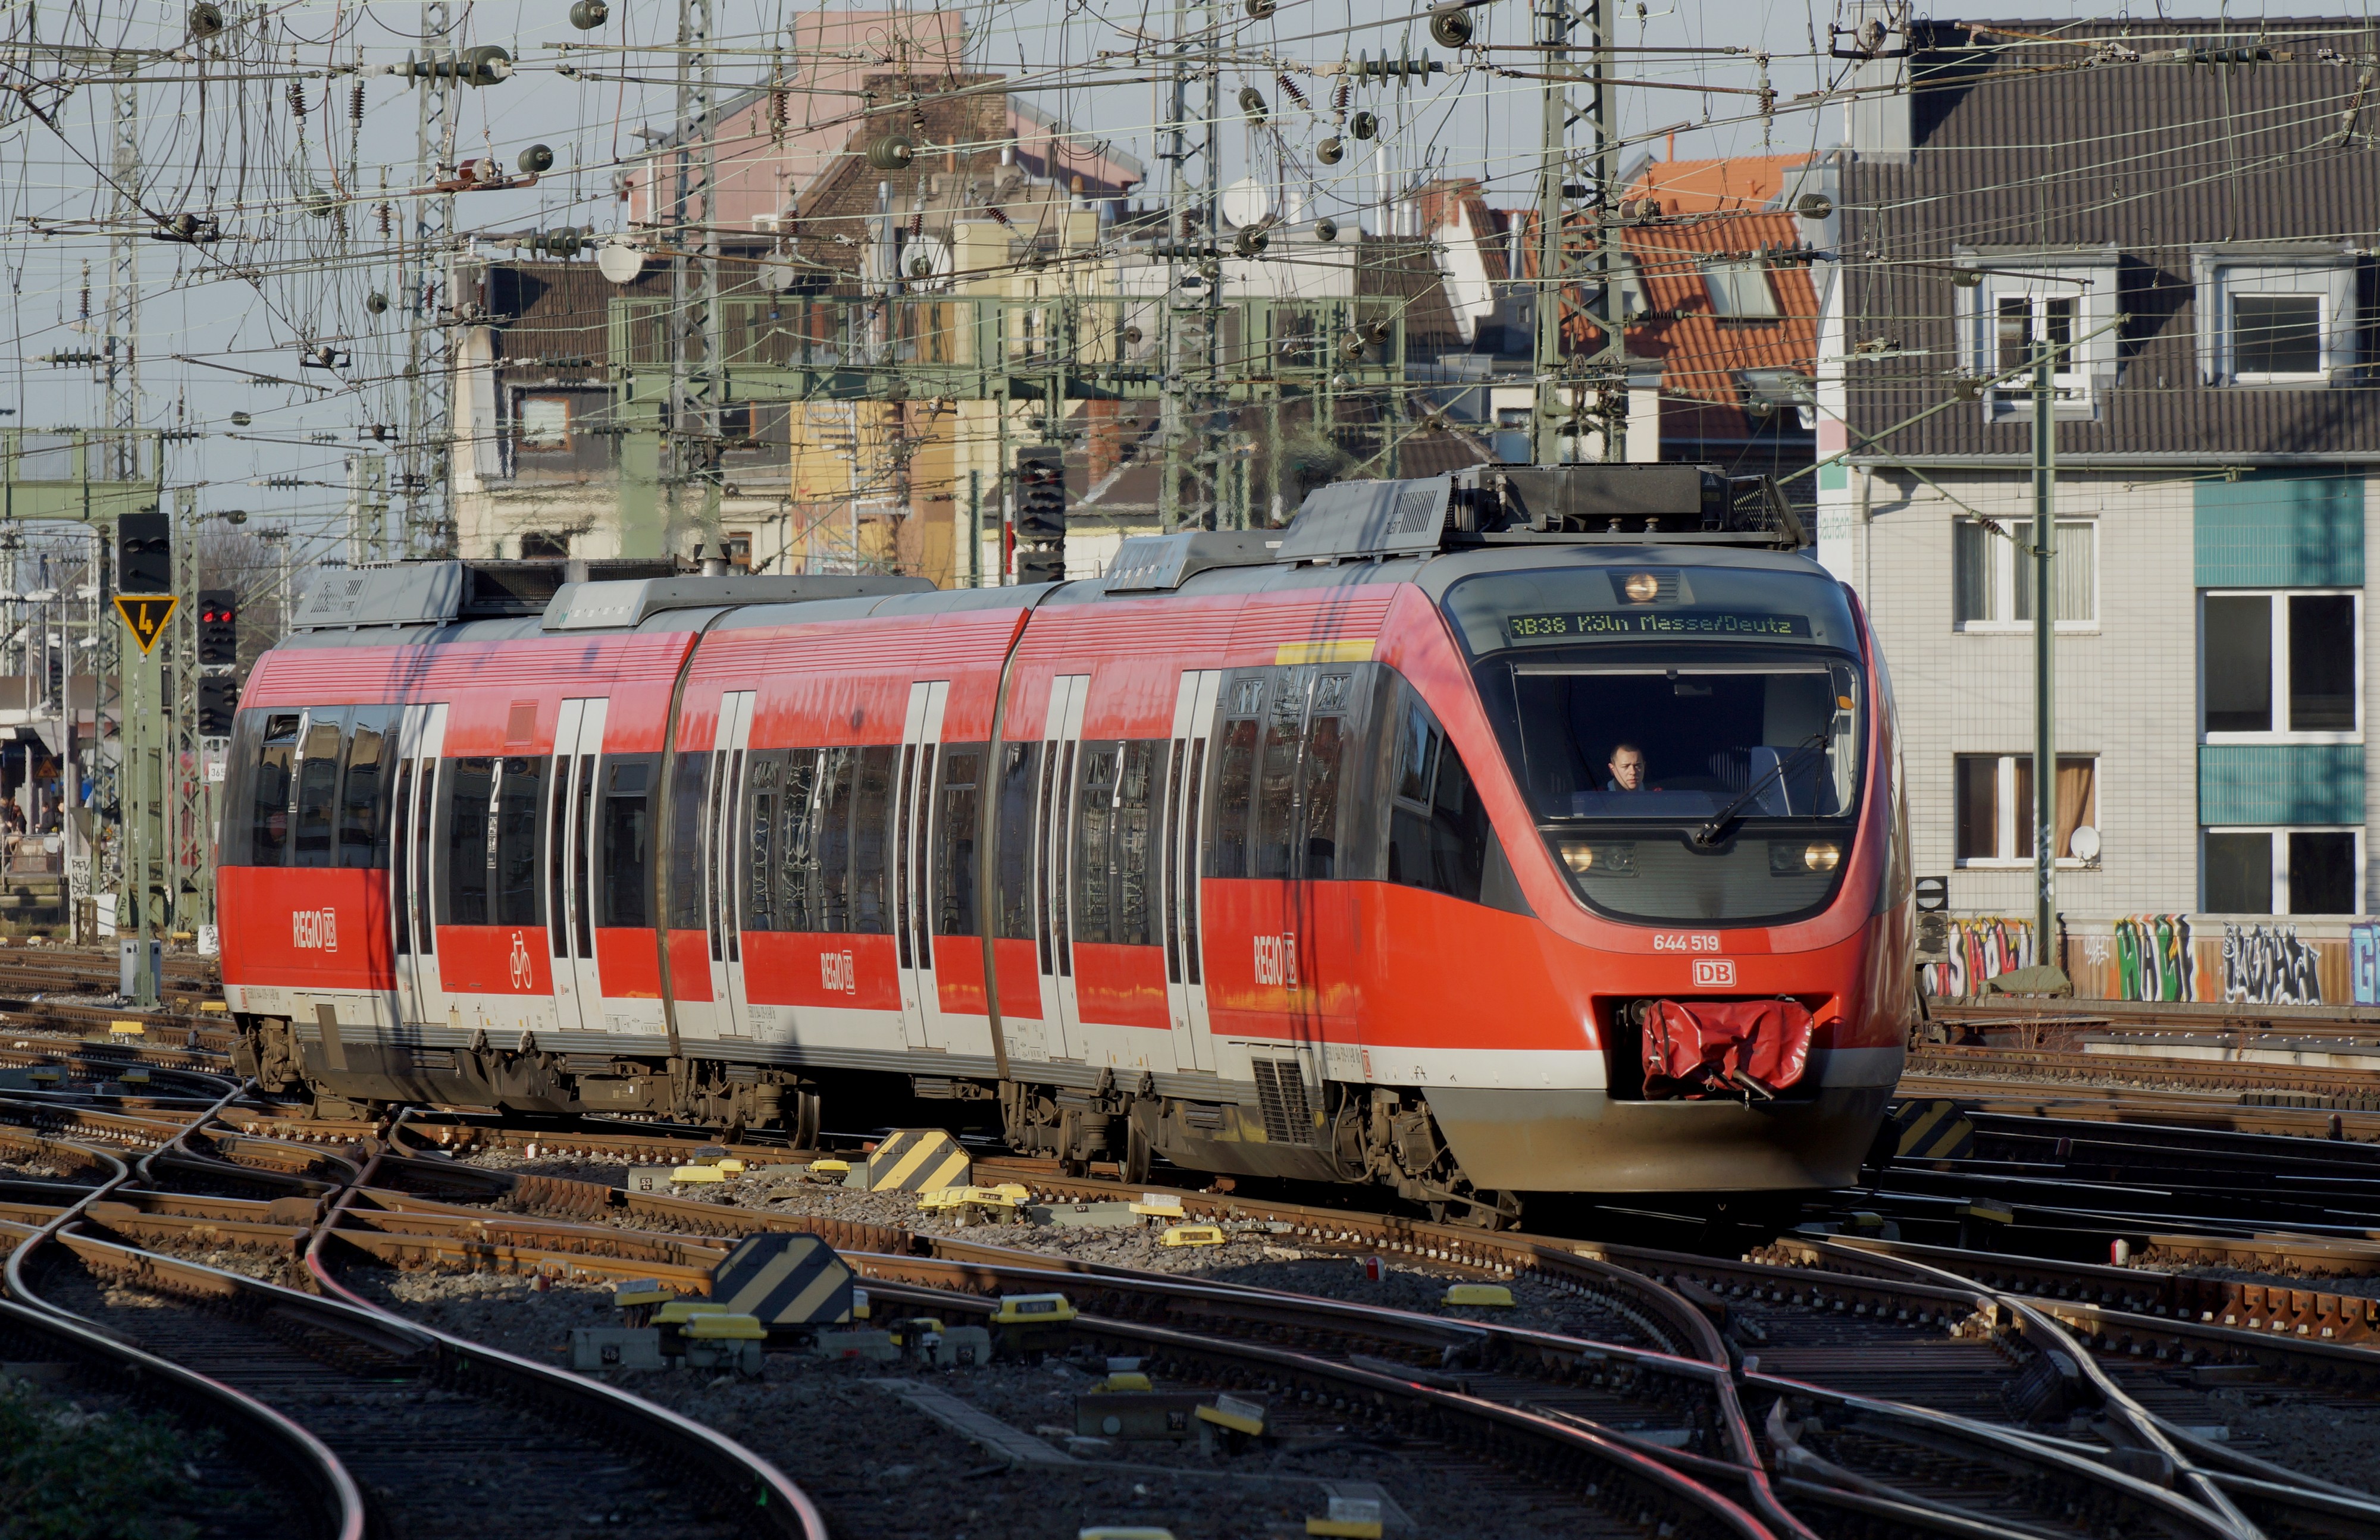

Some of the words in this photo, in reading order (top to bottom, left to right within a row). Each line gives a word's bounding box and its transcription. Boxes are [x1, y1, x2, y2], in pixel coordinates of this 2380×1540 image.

[138, 603, 153, 635] 4
[1512, 617, 1566, 635] RB38
[1577, 615, 1629, 632] Köln
[1640, 614, 1792, 633] Messe/Deutz
[294, 711, 308, 760] 2
[489, 761, 501, 812] 2
[814, 753, 824, 809] 2
[1113, 747, 1123, 807] 2
[293, 910, 322, 949] REGIO
[324, 912, 335, 948] DB
[1653, 934, 1686, 951] 644
[1691, 935, 1719, 951] 519
[821, 953, 843, 990] REGIO
[844, 954, 854, 991] DB
[1254, 936, 1282, 985] REGIO
[1283, 938, 1296, 985] DB
[1696, 962, 1733, 983] DB
